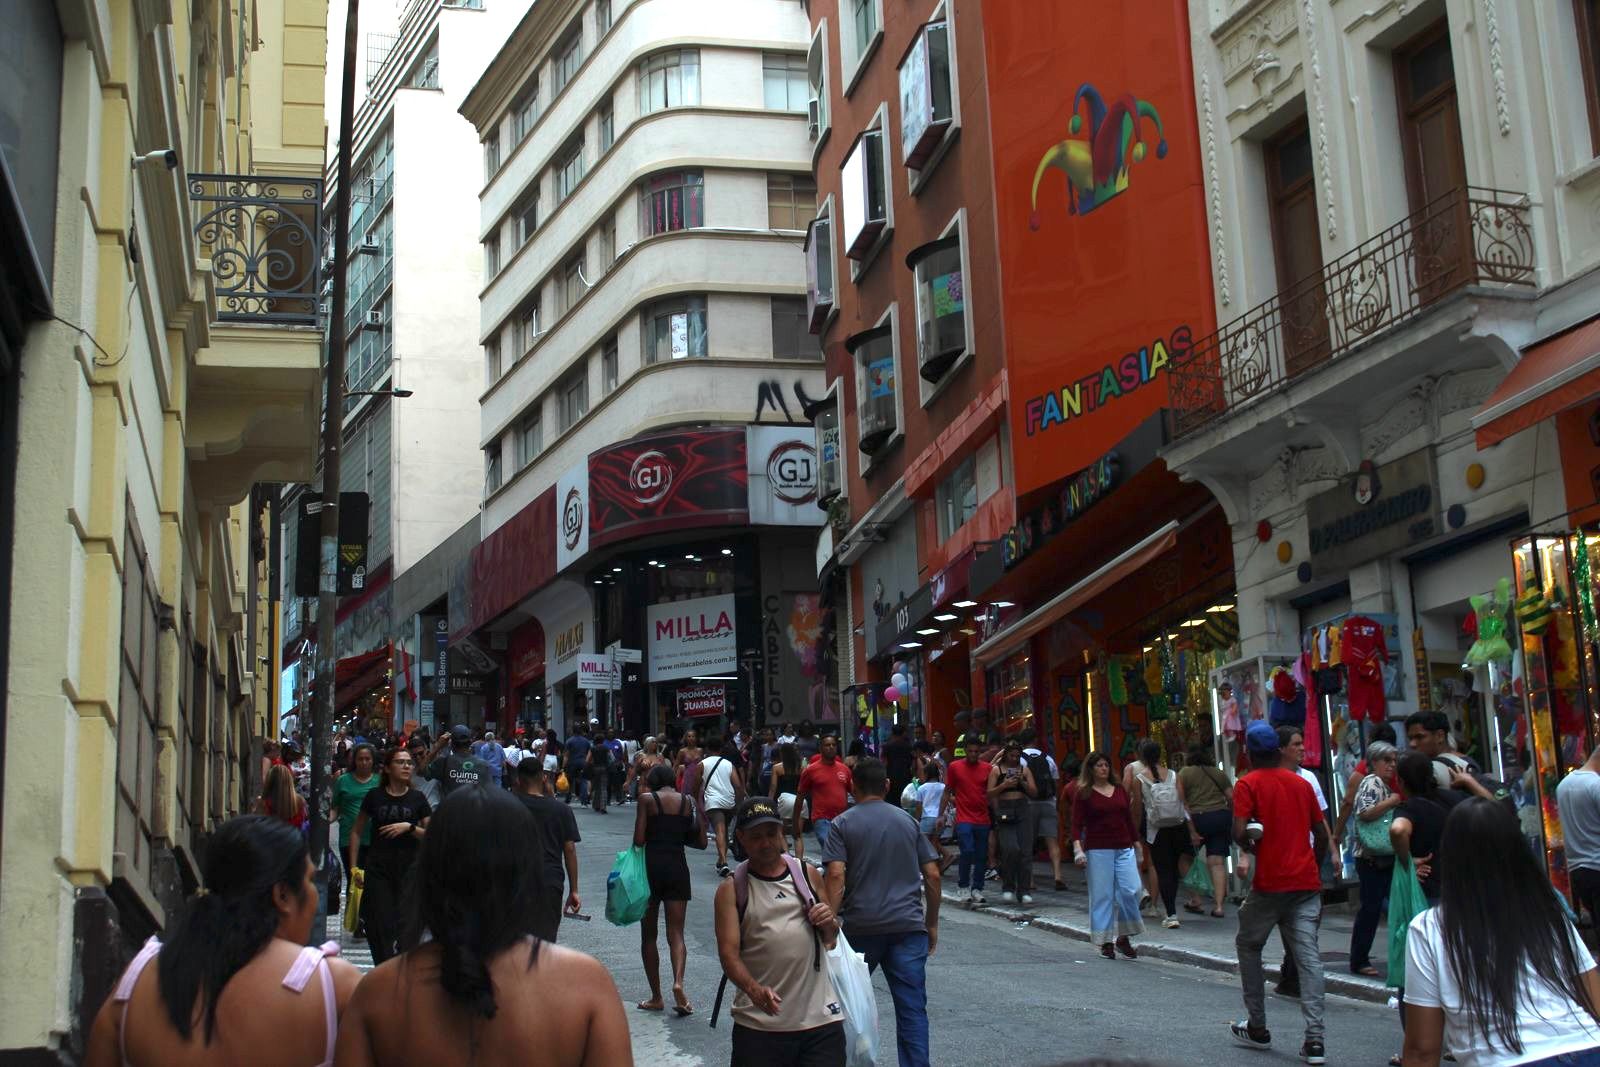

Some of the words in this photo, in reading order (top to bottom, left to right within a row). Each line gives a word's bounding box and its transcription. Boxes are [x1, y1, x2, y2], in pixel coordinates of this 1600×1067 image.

[1026, 325, 1193, 436] FANTASIAS
[636, 465, 662, 489] GJ
[778, 458, 810, 482] GJ
[567, 503, 578, 531] GJ
[656, 611, 733, 641] MILLA
[437, 650, 447, 675] Bento
[657, 656, 737, 671] www.millacabelos.com.br
[764, 595, 784, 717] CABELO
[581, 662, 619, 673] MILLA
[437, 676, 447, 695] São
[627, 674, 638, 683] 85
[678, 688, 724, 701] PROMOÇÃO
[683, 697, 724, 711] JUMBÃO
[449, 769, 479, 780] Guima
